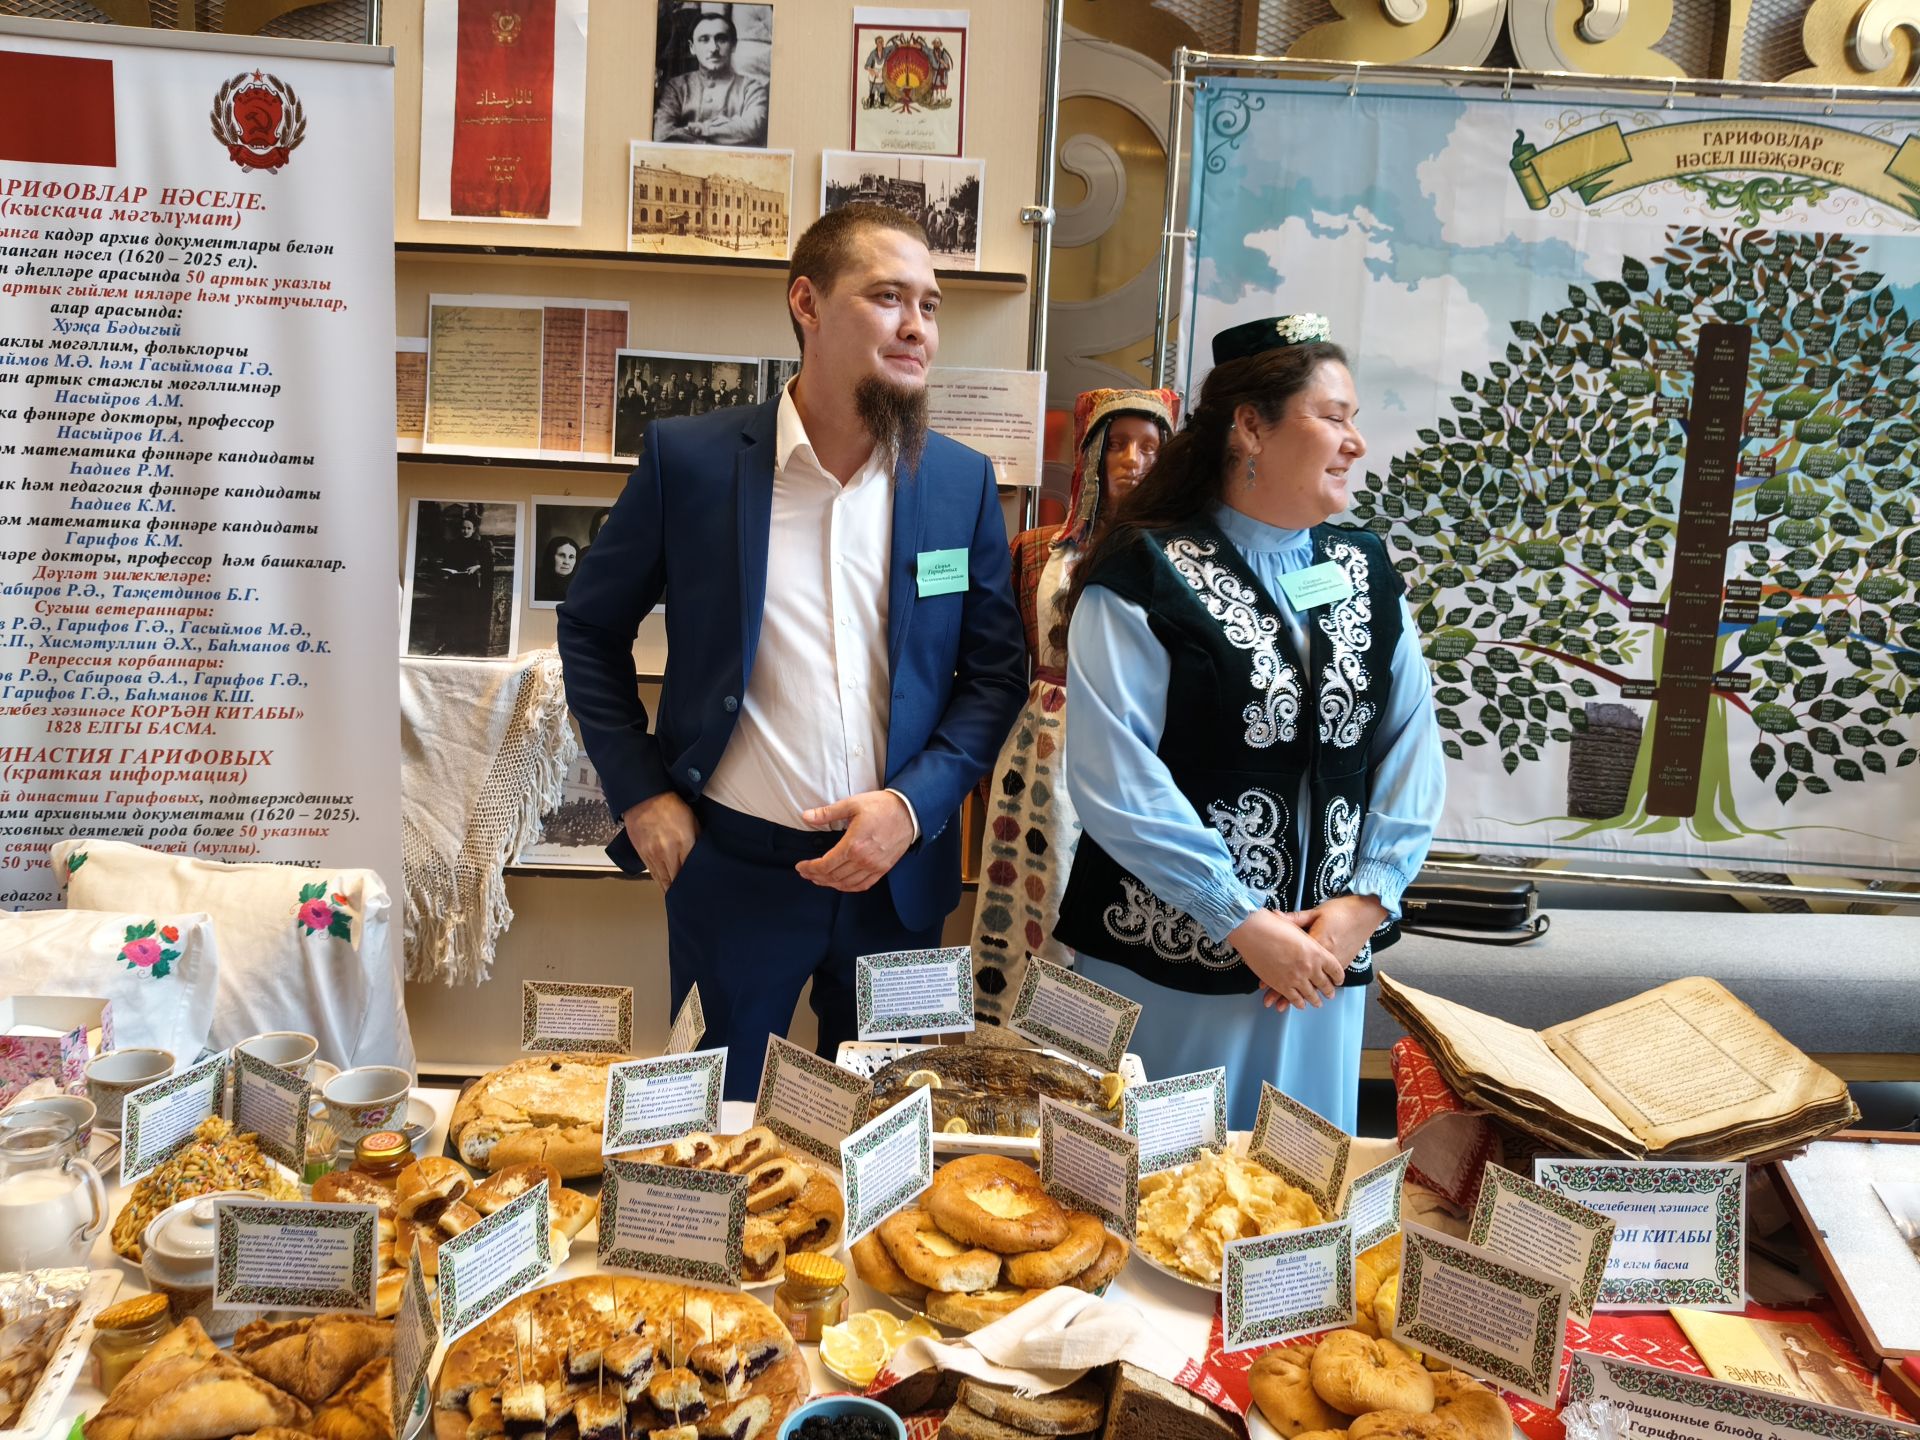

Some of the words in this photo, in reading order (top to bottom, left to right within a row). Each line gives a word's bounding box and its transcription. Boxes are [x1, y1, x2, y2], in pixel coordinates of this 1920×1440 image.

[1703, 131, 1824, 151] ГАРИФОВЛАР
[1676, 150, 1734, 169] НӘСЕЛ
[1739, 150, 1845, 177] ШӘҖӘРӘСЕ
[0, 178, 147, 203] РИФОВЛАР
[160, 188, 265, 210] НӘСЕЛЕ.
[1, 198, 102, 219] (кыскача
[109, 209, 241, 230] мәгълүмат)
[45, 228, 93, 245] кадәр
[100, 234, 149, 247] архив
[155, 233, 280, 254] документлары
[287, 240, 333, 254] белән
[64, 250, 112, 261] нәсел
[119, 249, 164, 264] (1620
[184, 252, 222, 266] 2025
[228, 256, 257, 271] ел).
[15, 262, 93, 281] әһелләре
[99, 269, 180, 283] арасында
[186, 270, 205, 283] 50
[210, 275, 268, 288] артык
[272, 279, 331, 291] указлы
[3, 284, 62, 297] артык
[67, 284, 127, 298] гыйлем
[135, 290, 192, 304] ияләре
[197, 288, 230, 303] һәм
[235, 295, 347, 312] укытучылар,
[51, 304, 89, 318] алар
[95, 305, 182, 319] арасында:
[53, 318, 100, 335] Хуҗа
[107, 321, 180, 336] Бәдыгый
[49, 340, 138, 354] мөгәллим,
[145, 340, 248, 359] фольклорчы
[55, 354, 92, 368] М.Ә.
[100, 356, 132, 370] һәм
[140, 358, 232, 374] Гасыймова
[239, 362, 272, 375] Г.Ә.
[26, 375, 82, 387] артык
[88, 377, 162, 389] стажлы
[168, 381, 280, 397] мөгәллимнәр
[55, 390, 140, 408] Насыйров
[146, 394, 183, 407] А.М.
[24, 407, 95, 425] фәннәре
[101, 410, 182, 428] докторы,
[188, 414, 274, 432] профессор
[57, 426, 142, 444] Насыйров
[148, 429, 183, 442] И.А.
[21, 446, 136, 458] математика
[142, 446, 212, 464] фәннәре
[218, 451, 314, 465] кандидаты
[137, 464, 173, 477] Р.М.
[22, 478, 53, 491] һәм
[60, 480, 142, 494] педагогия
[149, 482, 219, 499] фәннәре
[225, 486, 320, 500] кандидаты
[137, 499, 175, 512] К.М.
[27, 517, 140, 528] математика
[147, 517, 217, 534] фәннәре
[223, 520, 318, 534] кандидаты
[66, 532, 138, 549] Гарифов
[144, 534, 182, 547] К.М.
[42, 549, 121, 566] докторы,
[127, 552, 212, 569] профессор
[223, 554, 254, 566] һәм
[261, 555, 345, 572] башкалар.
[32, 566, 97, 582] Дәүләт
[104, 571, 211, 585] эшлеклеләре:
[67, 584, 104, 599] Р.Ә.,
[113, 585, 220, 600] Таҗетдинов
[227, 588, 258, 601] Б.Г.
[35, 600, 89, 616] Сугыш
[96, 605, 213, 619] ветераннары:
[12, 617, 50, 632] Р.Ә.,
[57, 618, 128, 635] Гарифов
[135, 620, 173, 634] Г.Ә.,
[180, 621, 262, 635] Гасыймов
[268, 623, 310, 637] М.Ә.,
[39, 635, 156, 652] Хисмәтуллин
[163, 637, 201, 652] Ә.Х.,
[208, 639, 290, 652] Баһманов
[296, 640, 331, 653] Ф.К.
[28, 652, 111, 668] Репрессия
[118, 655, 223, 671] корбаннары:
[19, 669, 57, 684] Р.Ә.,
[64, 670, 142, 686] Сабирова
[148, 671, 187, 685] Ә.А.,
[194, 672, 264, 689] Гарифов
[270, 674, 307, 687] Г.Ә.,
[2, 686, 75, 702] Гарифов
[81, 687, 118, 702] Г.Ә.,
[125, 688, 207, 701] Баһманов
[213, 690, 253, 702] К.Ш.
[51, 707, 125, 717] хәзинәсе
[131, 705, 210, 718] КОРЪӘН
[215, 707, 303, 719] КИТАБЫ»
[46, 720, 81, 733] 1828
[87, 721, 142, 734] ЕЛГЫ
[148, 722, 216, 735] БАСМА.
[119, 749, 273, 765] ГАРИФОВЫХ
[4, 765, 101, 784] (краткая
[110, 766, 247, 785] информация)
[16, 790, 98, 803] династии
[105, 791, 203, 806] Гарифовых,
[209, 792, 353, 807] подтвержденных
[35, 810, 126, 822] архивными
[133, 808, 244, 823] документами
[251, 808, 294, 822] (1620
[314, 808, 359, 823] 2025).
[69, 824, 144, 836] деятелей
[148, 825, 187, 840] рода
[193, 824, 234, 836] более
[240, 825, 257, 837] 50
[261, 828, 329, 840] указных
[194, 841, 260, 856] (муллы).
[1, 856, 20, 868] 50
[1658, 1201, 1709, 1213] хәзинәсе
[1642, 1229, 1712, 1243] КИТАБЫ
[1623, 1261, 1651, 1271] елгы
[1654, 1258, 1689, 1270] басма
[1714, 1420, 1763, 1440] блюда
